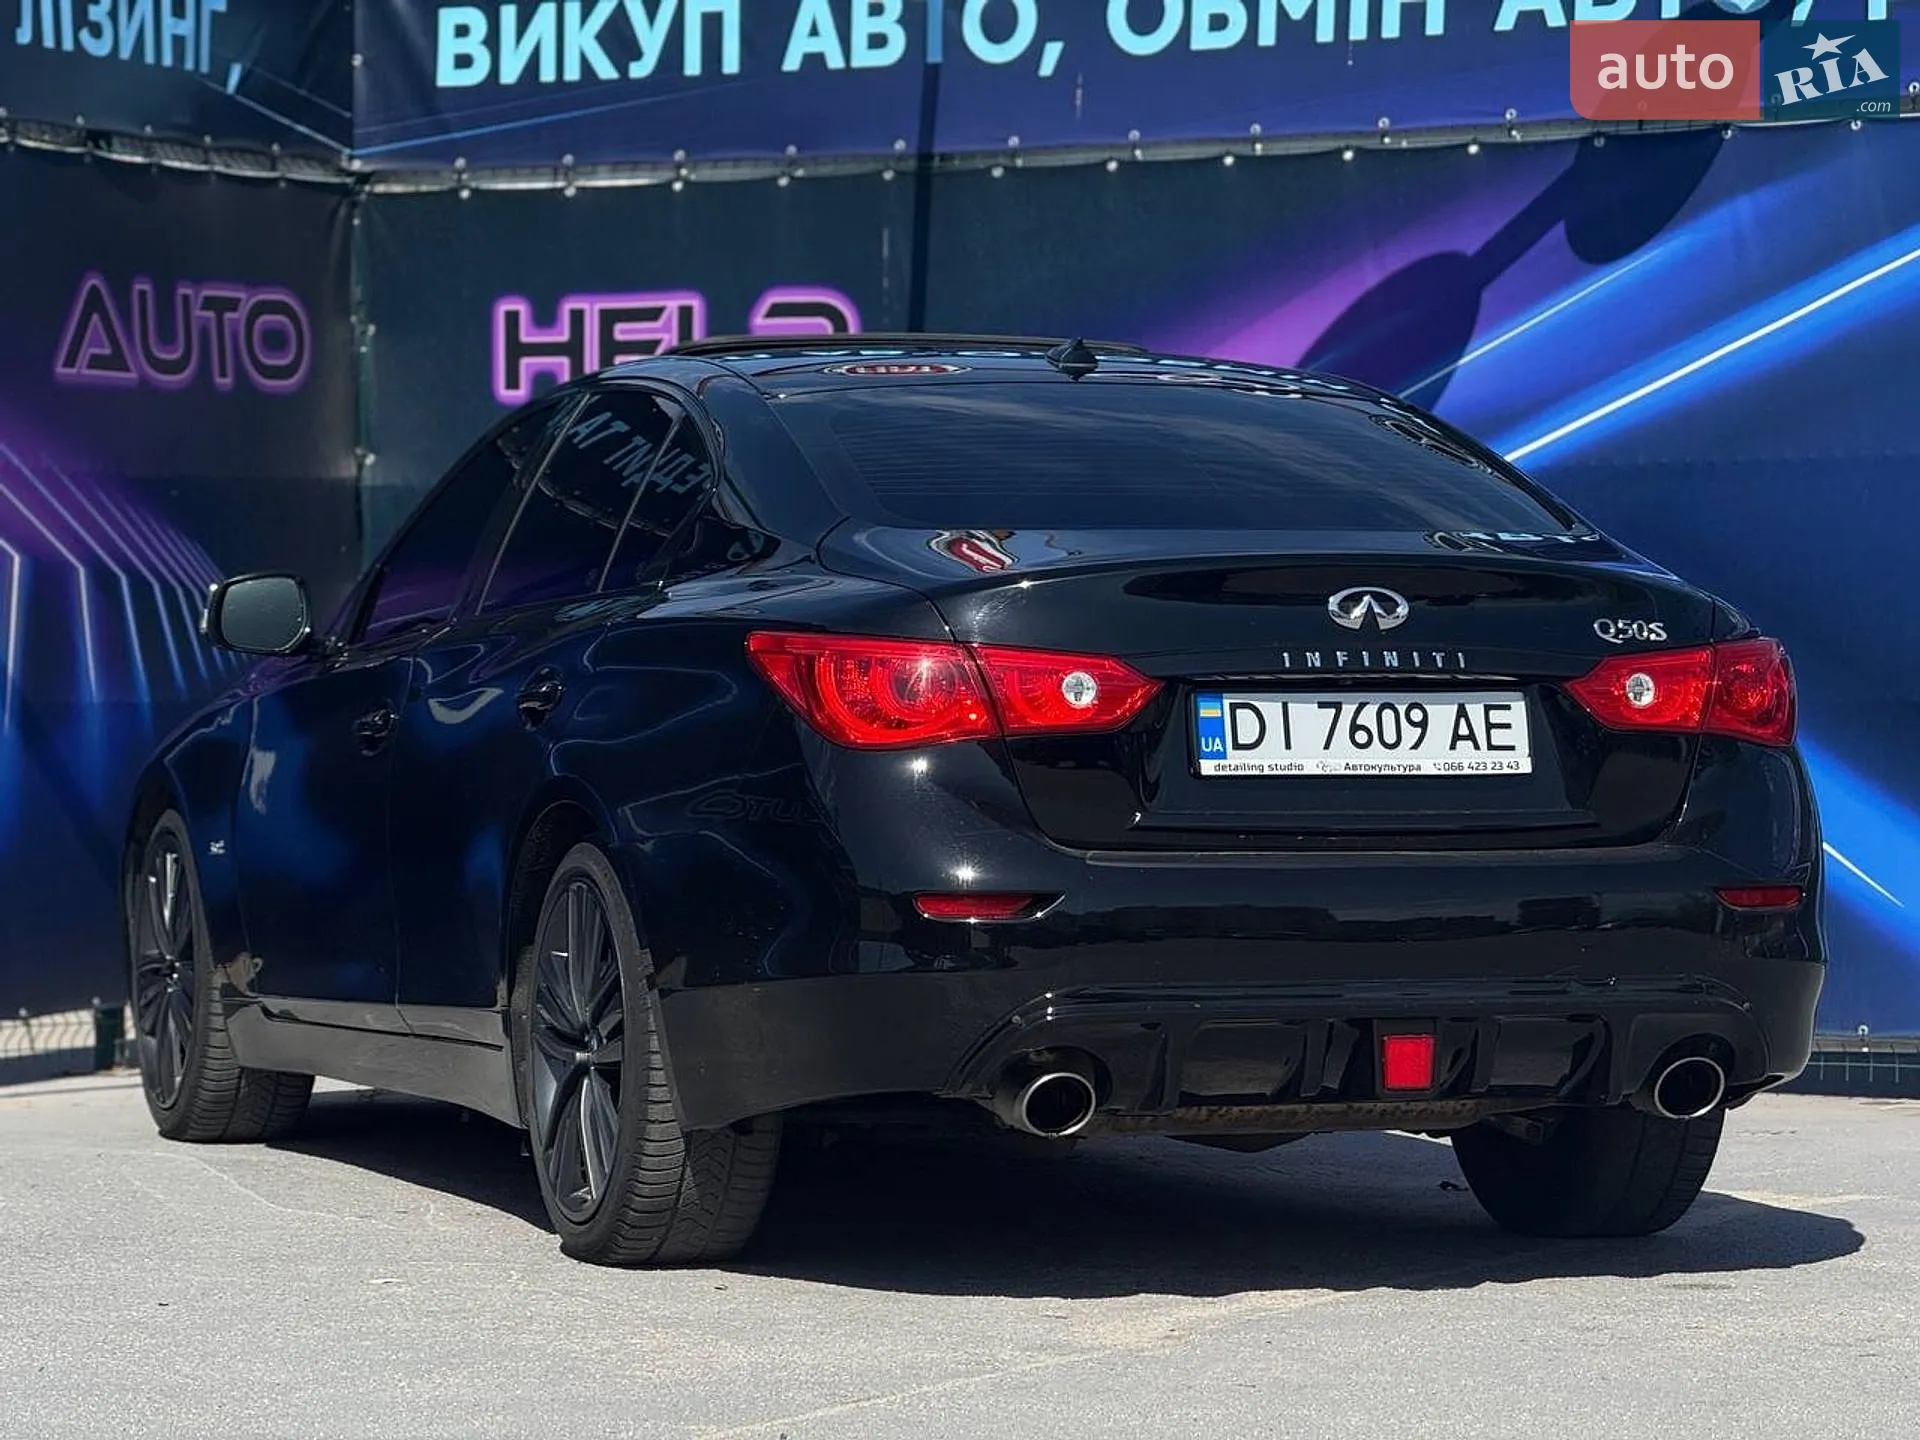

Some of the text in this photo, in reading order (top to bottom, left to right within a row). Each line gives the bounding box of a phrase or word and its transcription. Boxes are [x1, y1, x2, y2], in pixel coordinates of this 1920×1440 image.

[435, 0, 741, 88] ВИКУП
[780, 0, 1065, 77] АВТО,
[55, 273, 312, 391] AUTO
[1593, 618, 1668, 643] Q50S
[1282, 651, 1466, 668] INFINITI
[1228, 701, 1516, 751] DI 7609 AE
[1201, 736, 1224, 752] UA
[1213, 761, 1305, 773] detailing studio
[1442, 760, 1521, 772] 066 423 23 43
